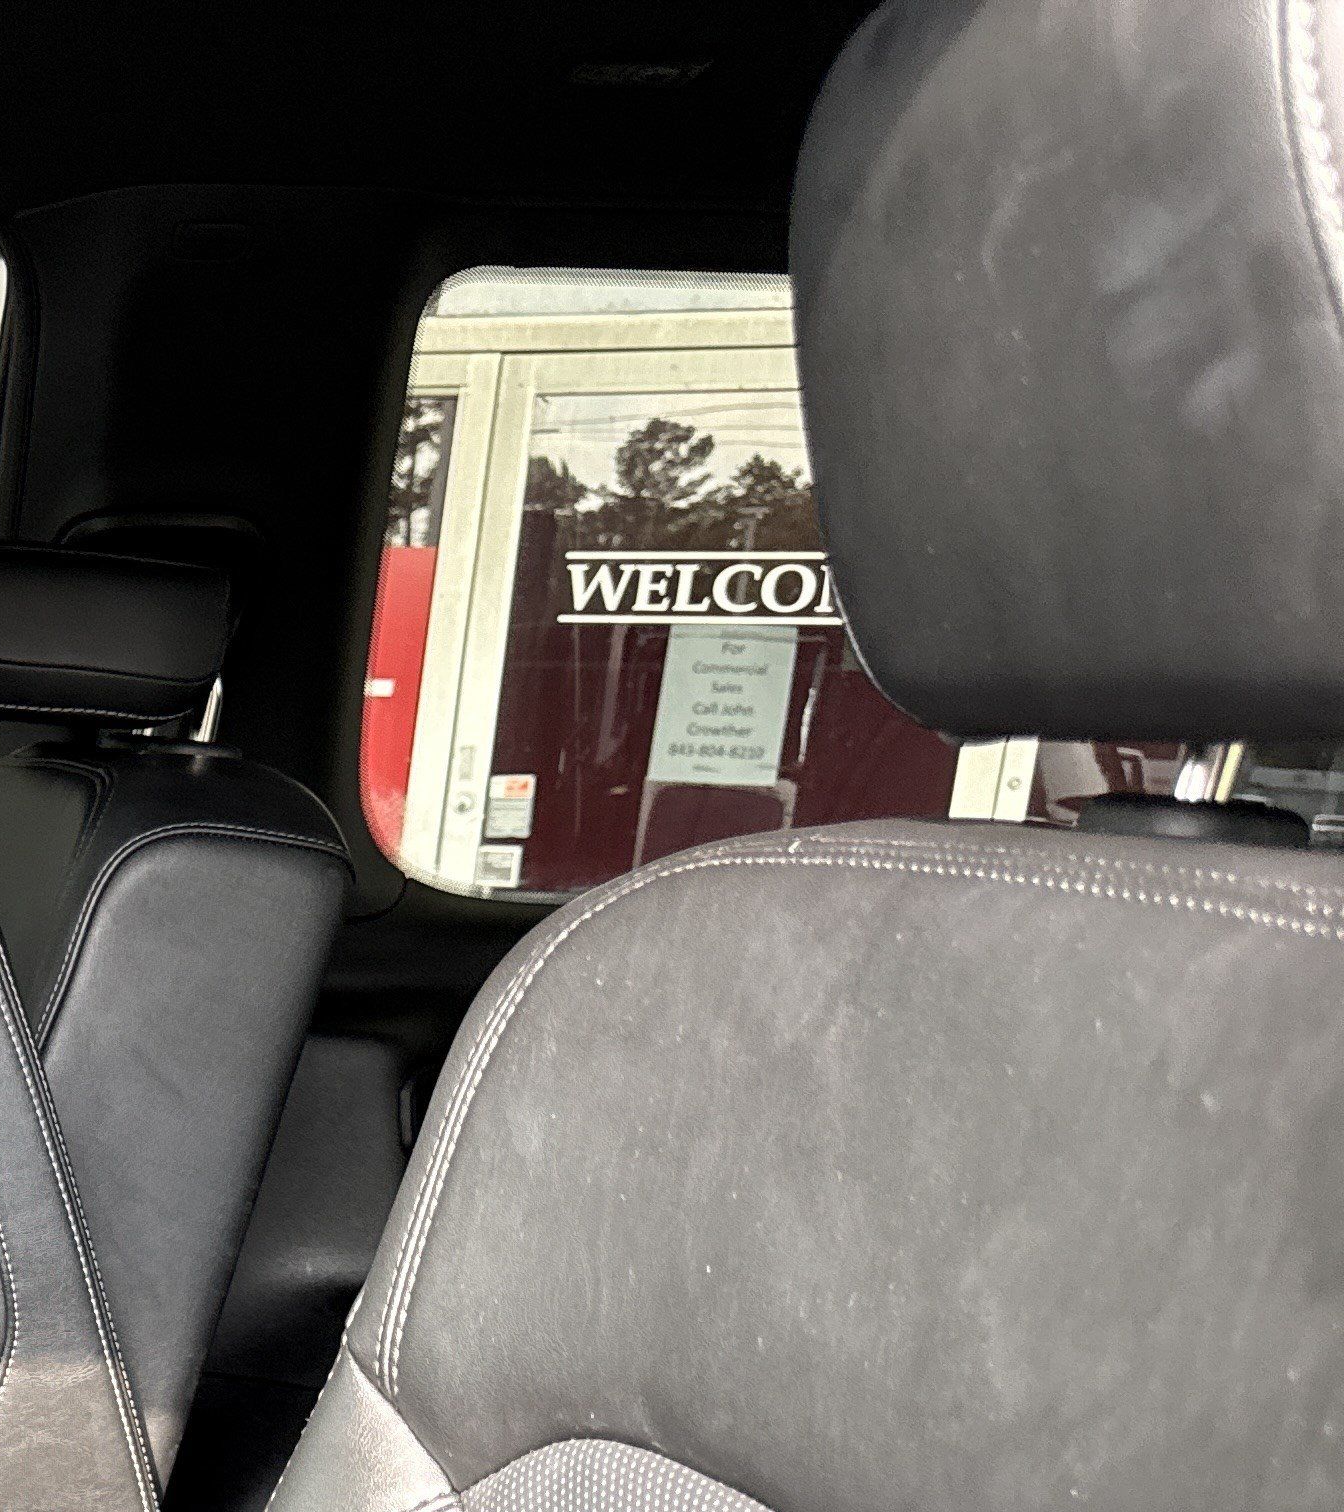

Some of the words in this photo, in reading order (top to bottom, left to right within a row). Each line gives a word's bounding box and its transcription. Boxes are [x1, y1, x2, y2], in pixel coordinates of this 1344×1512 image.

[721, 641, 746, 655] For
[692, 660, 768, 676] Commercial
[711, 681, 743, 694] Sales
[692, 702, 719, 716] Call
